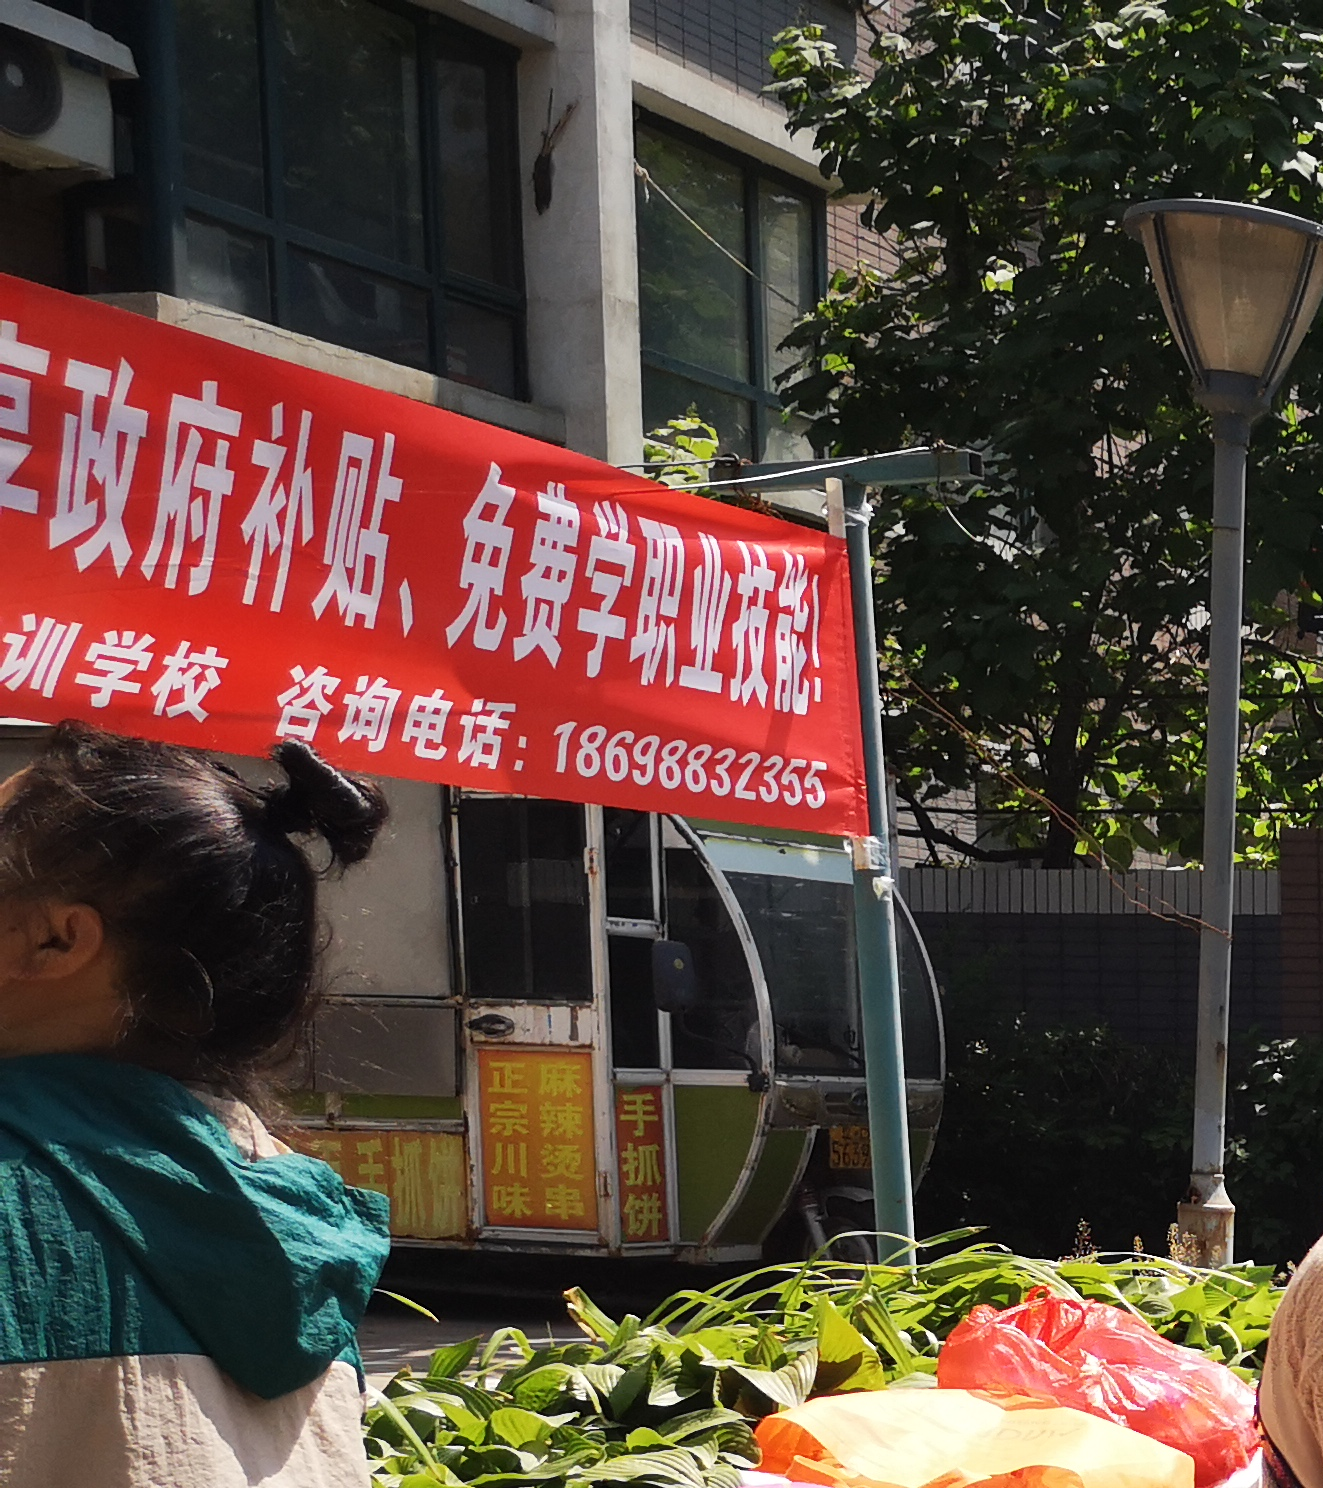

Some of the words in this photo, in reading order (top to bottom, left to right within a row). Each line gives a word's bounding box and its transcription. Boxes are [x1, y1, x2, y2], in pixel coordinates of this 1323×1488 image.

[0, 613, 229, 723] 训学校
[487, 1060, 533, 1218] 正宗川味
[538, 1060, 585, 1220] 麻辣烫串
[619, 1092, 663, 1236] 手抓饼
